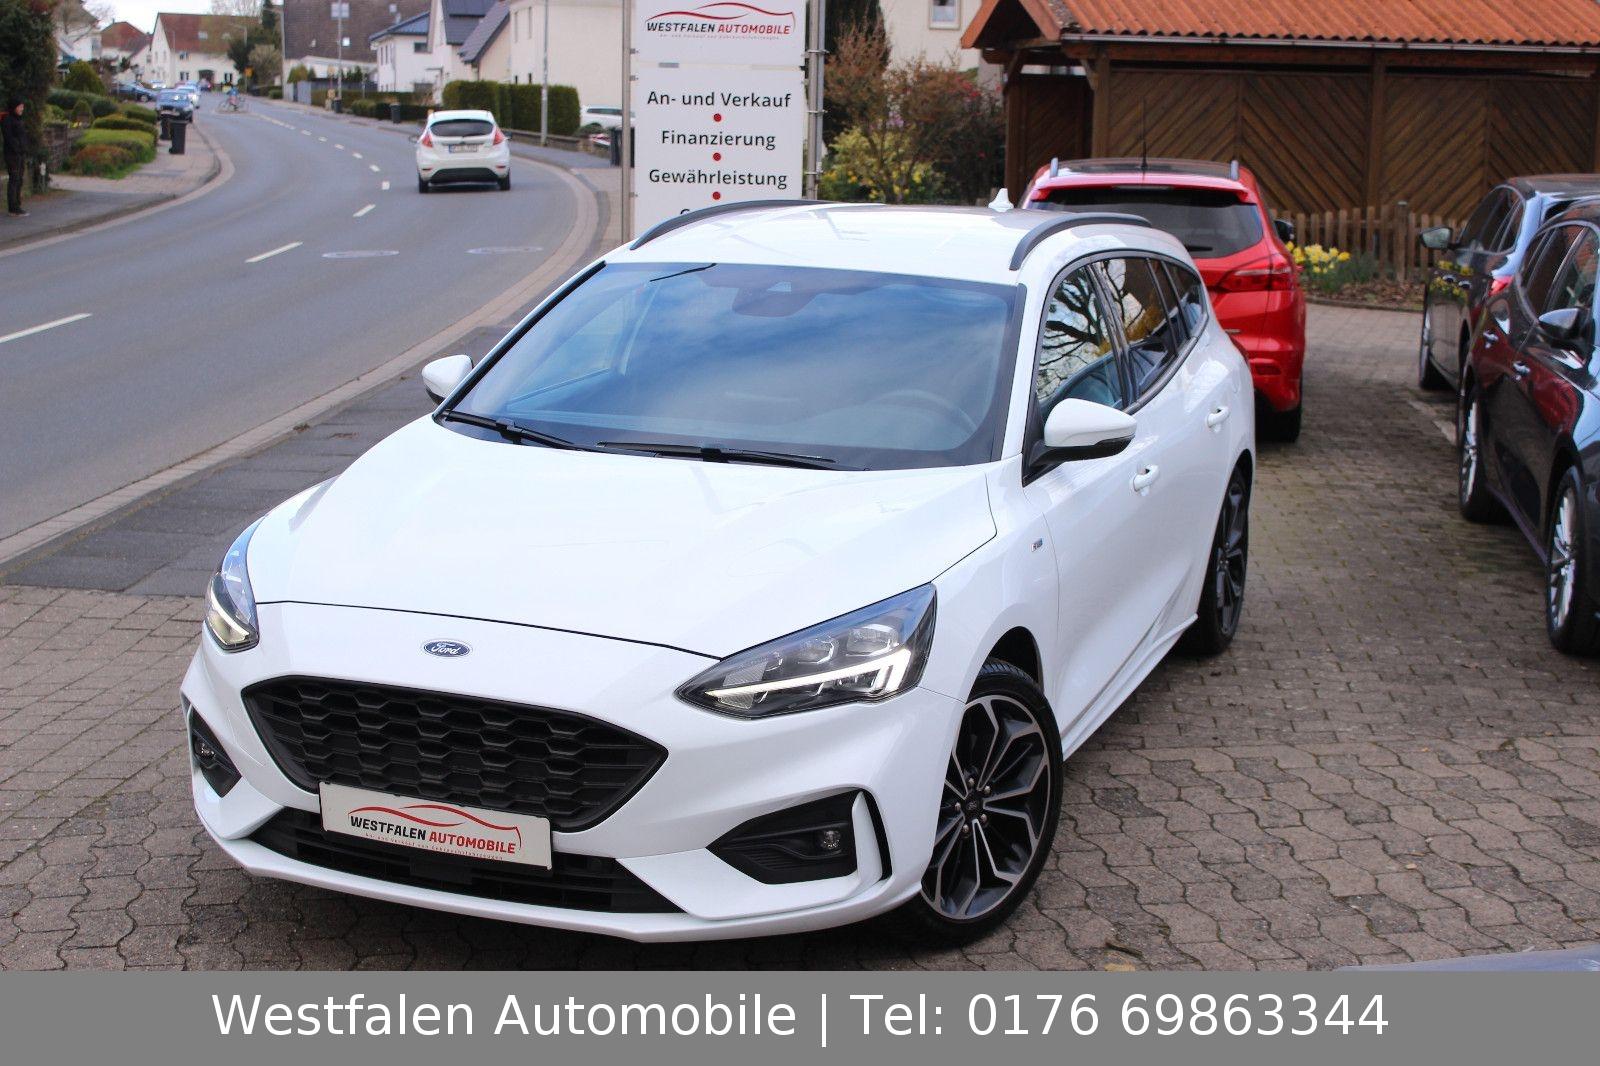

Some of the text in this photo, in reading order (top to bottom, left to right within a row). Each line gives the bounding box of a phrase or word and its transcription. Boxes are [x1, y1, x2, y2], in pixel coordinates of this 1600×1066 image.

[647, 22, 791, 35] WESTFALEN AUTOMOBILE
[647, 91, 791, 108] An- und Verkauf
[661, 131, 776, 150] Finanzierung
[649, 169, 788, 190] Gewährleistung
[350, 815, 427, 841] WESTFALEN
[428, 831, 517, 854] AUTOMOBILE
